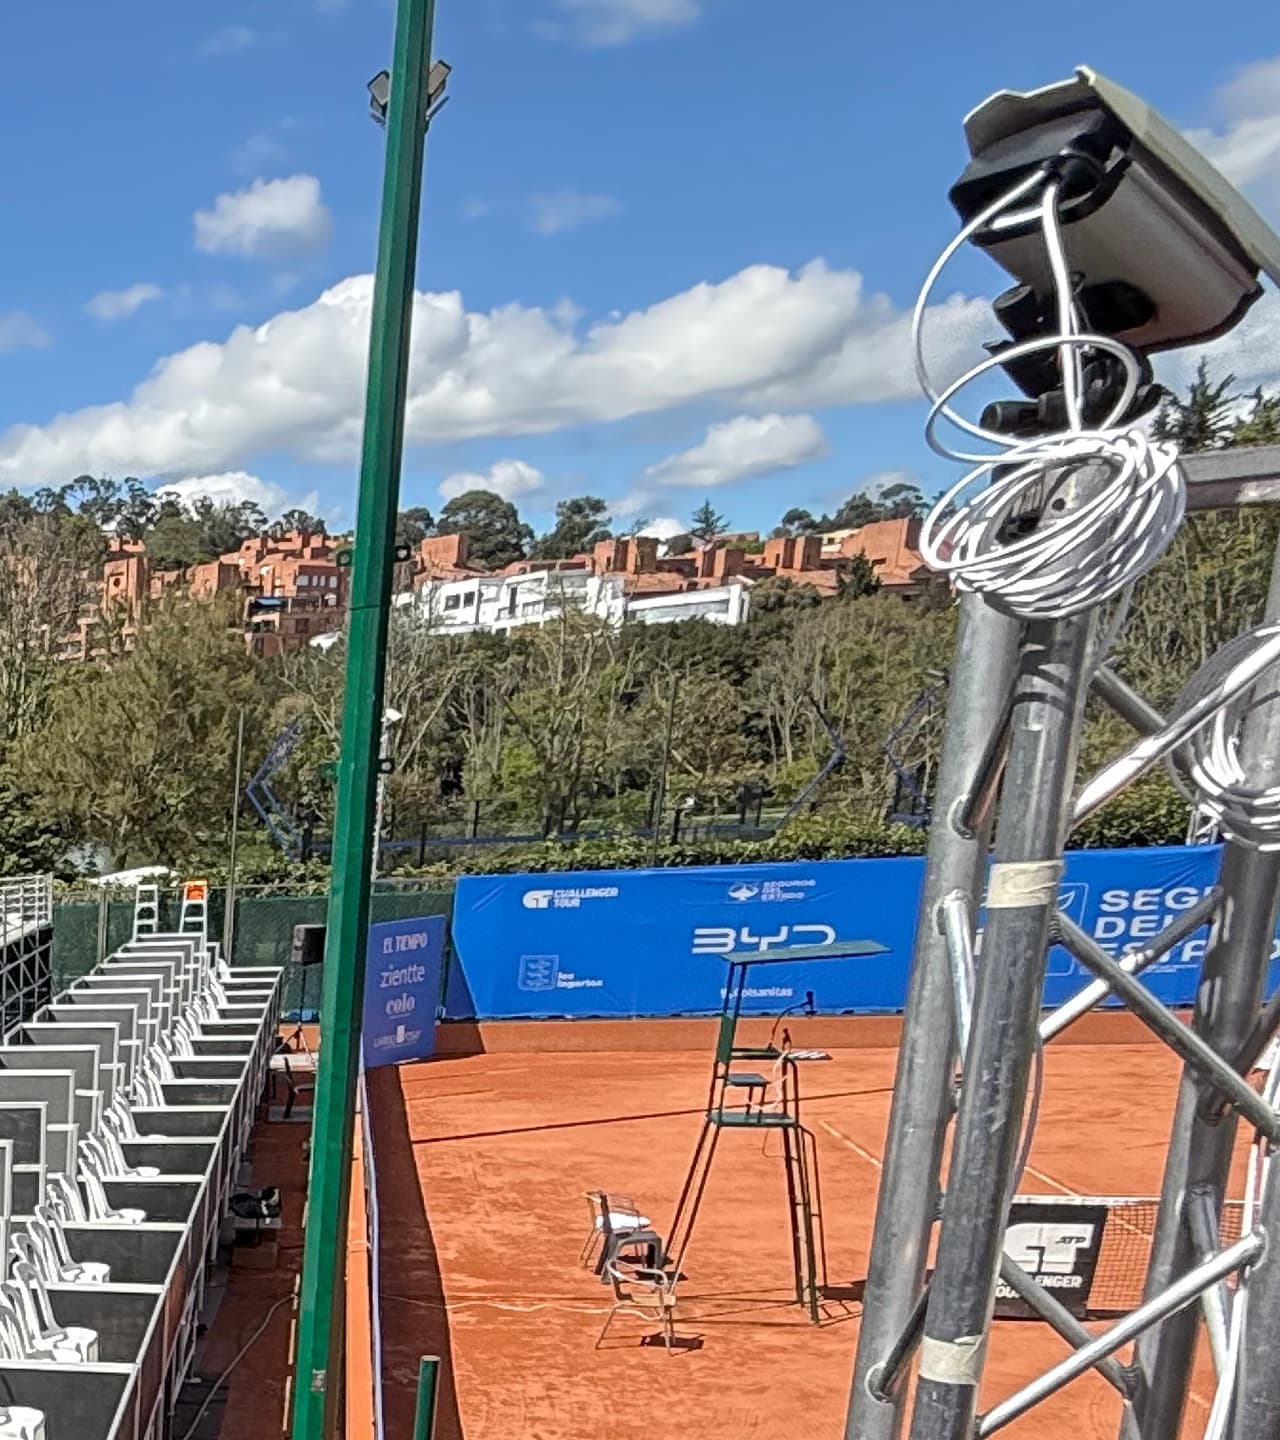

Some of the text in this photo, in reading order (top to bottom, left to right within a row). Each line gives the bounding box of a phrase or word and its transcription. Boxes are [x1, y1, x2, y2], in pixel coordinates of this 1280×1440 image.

[1100, 885, 1213, 912] SEG
[394, 932, 428, 952] TIEMPO
[691, 924, 836, 954] BYD
[380, 964, 426, 988] zientte
